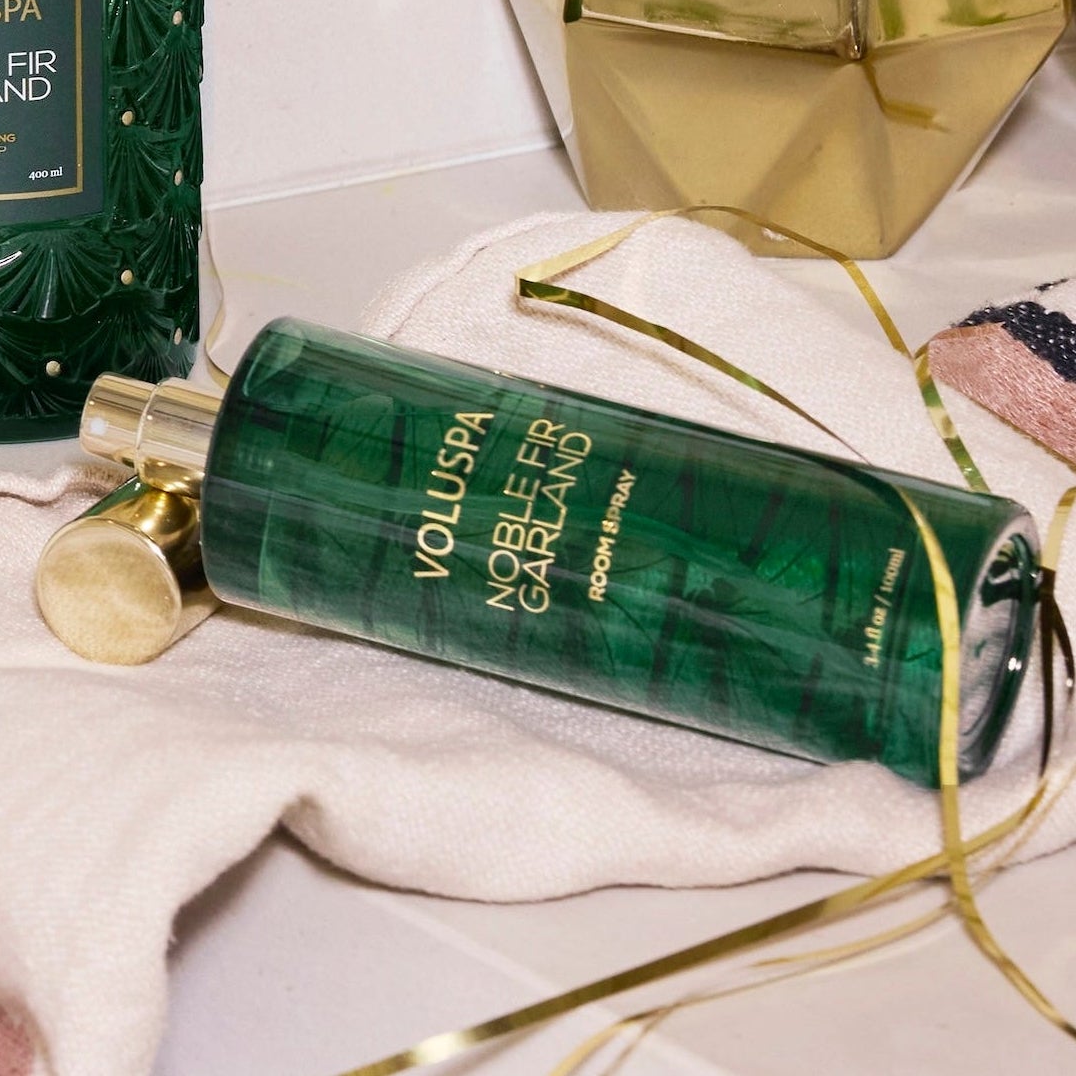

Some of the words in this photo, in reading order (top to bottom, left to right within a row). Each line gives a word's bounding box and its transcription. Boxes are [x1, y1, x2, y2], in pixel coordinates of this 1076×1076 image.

[8, 50, 57, 75] FIR
[28, 170, 49, 181] 400
[50, 167, 63, 178] ml
[414, 412, 494, 578] VOLUSPA
[486, 473, 540, 611] NOBLE
[516, 418, 566, 468] FIR
[518, 432, 592, 613] GARLAND
[588, 536, 616, 602] ROOM
[602, 469, 636, 534] SPRAY
